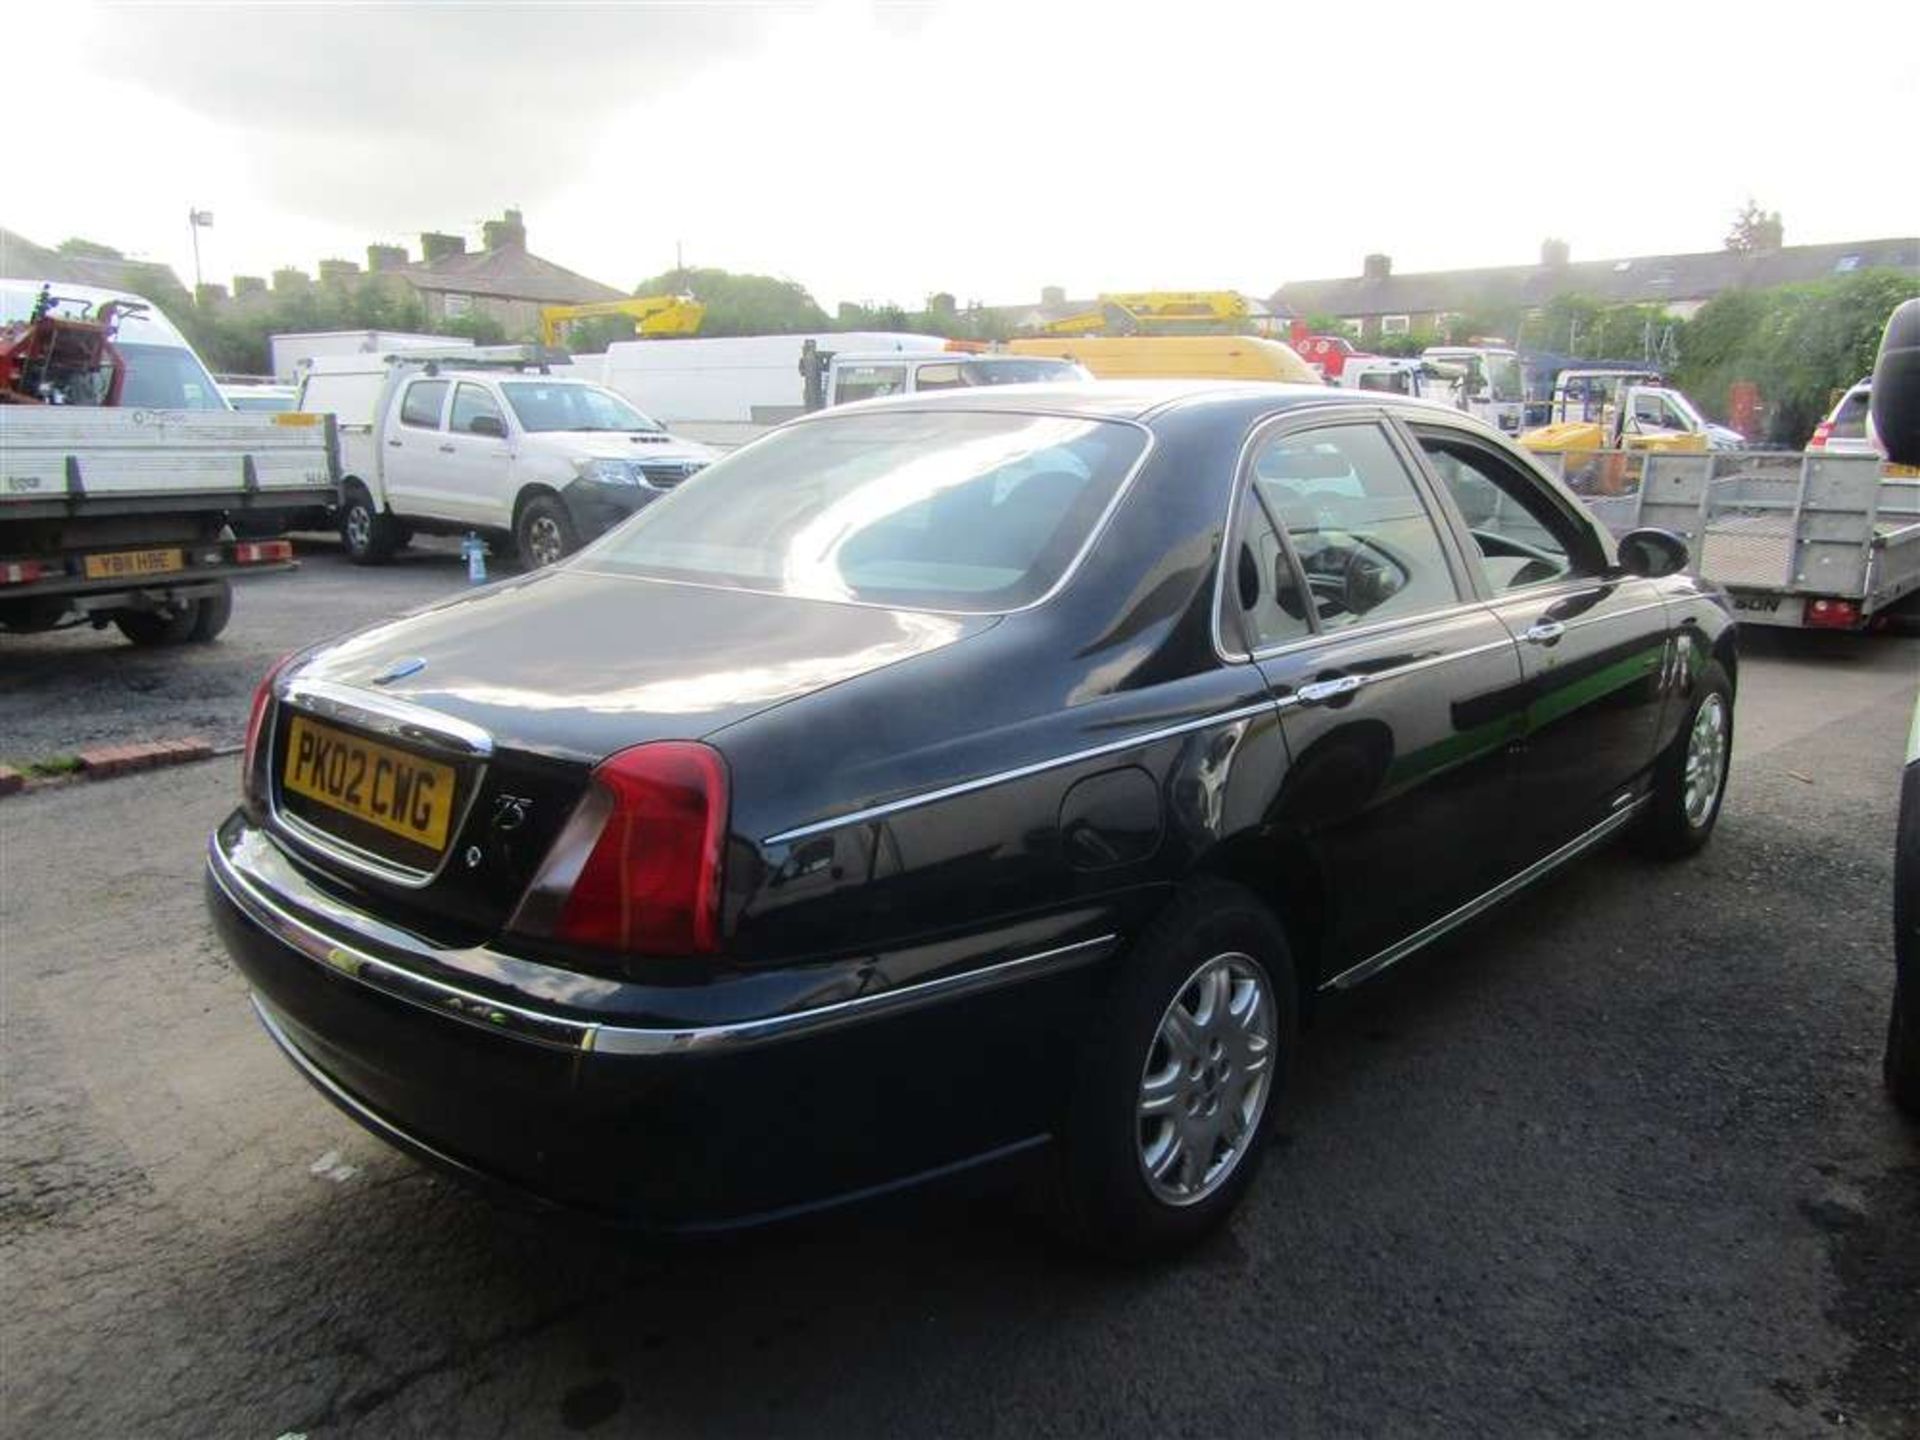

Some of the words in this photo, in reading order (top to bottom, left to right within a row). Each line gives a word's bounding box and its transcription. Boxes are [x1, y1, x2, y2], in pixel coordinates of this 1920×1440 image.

[294, 731, 367, 805] PK02
[370, 757, 436, 833] CWG
[492, 793, 533, 830] 75
